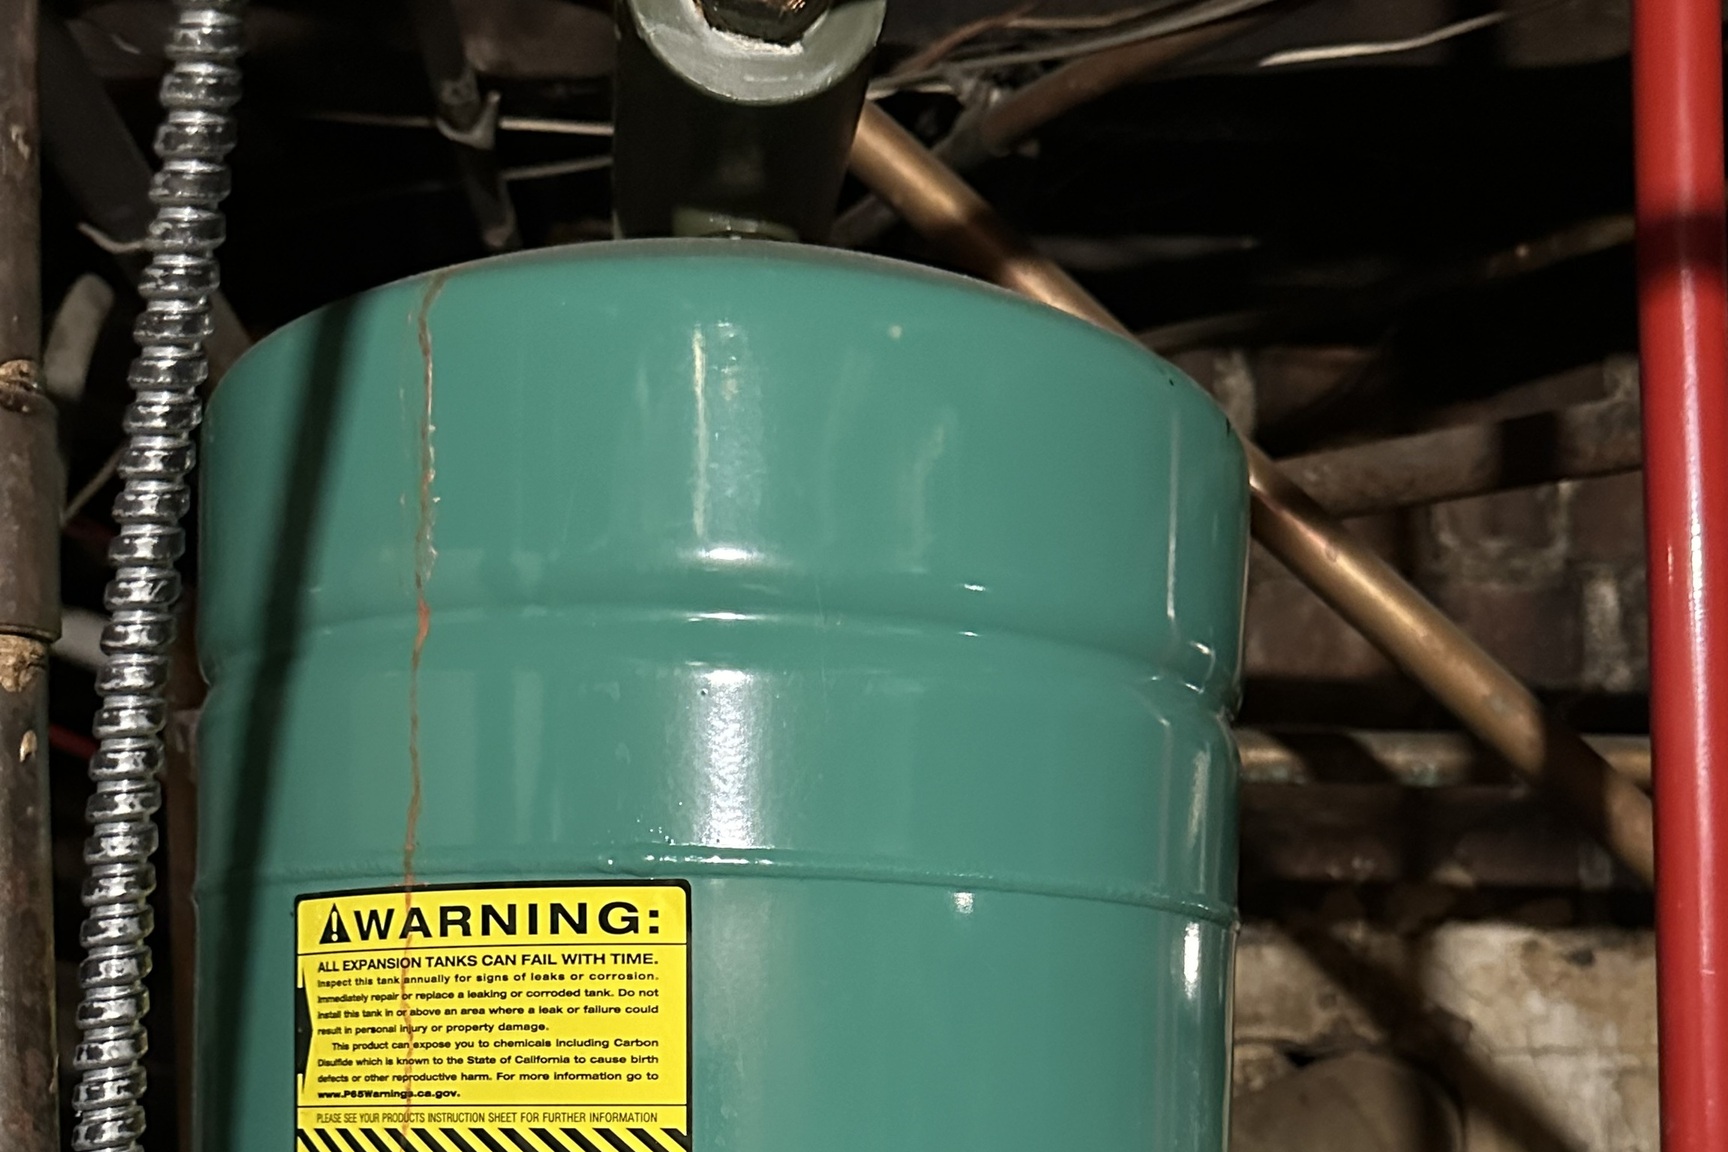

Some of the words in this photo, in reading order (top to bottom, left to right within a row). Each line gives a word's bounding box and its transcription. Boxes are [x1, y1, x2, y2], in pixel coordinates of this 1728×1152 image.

[353, 901, 660, 941] WARNING:
[318, 962, 339, 972] ALL
[343, 957, 421, 971] EXPANSION
[425, 955, 477, 967] TANKS
[482, 954, 516, 966] CAN
[521, 954, 557, 965] FAIL
[562, 954, 606, 965] WITH
[610, 953, 658, 964] TIME.
[355, 977, 373, 985] this
[378, 976, 400, 984] tank
[403, 974, 450, 984] annually
[455, 974, 471, 982] for
[476, 973, 508, 983] signs
[531, 972, 565, 980] leaks
[589, 972, 658, 980] corrosion.
[371, 993, 399, 1002] repair
[416, 991, 454, 1000] replace
[468, 990, 507, 1000] leaking
[526, 989, 580, 997] corroded
[584, 989, 614, 997] tank.
[618, 989, 635, 997] Do
[639, 989, 658, 997] not
[344, 1010, 359, 1018] this
[410, 1008, 441, 1016] above
[489, 1006, 524, 1014] where
[539, 1006, 563, 1014] leak
[584, 1005, 621, 1013] failure
[625, 1005, 658, 1013] could
[318, 1027, 342, 1035] result
[355, 1025, 396, 1035] personal
[400, 1024, 427, 1034] injury
[446, 1023, 494, 1033] property
[498, 1023, 549, 1032] damage.
[332, 1042, 349, 1050] This
[352, 1042, 388, 1051] product
[413, 1041, 450, 1050] expose
[455, 1041, 474, 1050] you
[478, 1040, 489, 1048] to
[494, 1039, 551, 1048] chemicals
[556, 1039, 609, 1048] including
[614, 1039, 658, 1047] Carbon
[318, 1059, 353, 1067] Disulfide
[356, 1058, 382, 1066] which
[467, 1056, 496, 1064] State
[515, 1055, 570, 1063] California
[631, 1055, 658, 1063] birth
[364, 1074, 388, 1082] other
[392, 1073, 457, 1082] reproductive
[461, 1073, 492, 1081] harm.
[497, 1072, 515, 1080] For
[554, 1072, 622, 1080] information
[627, 1073, 641, 1081] go
[646, 1072, 658, 1080] to
[318, 1090, 460, 1098] www.P65Warnings.ca.gov.
[316, 1112, 342, 1123] PLEASE
[344, 1112, 357, 1122] SEE
[360, 1112, 379, 1122] YOUR
[382, 1112, 425, 1122] PRODUCTS
[428, 1112, 485, 1122] INSTRUCTION
[488, 1112, 517, 1122] SHEET
[521, 1112, 539, 1122] FOR
[542, 1112, 586, 1122] FURTHER
[590, 1112, 657, 1122] INFORMATION
